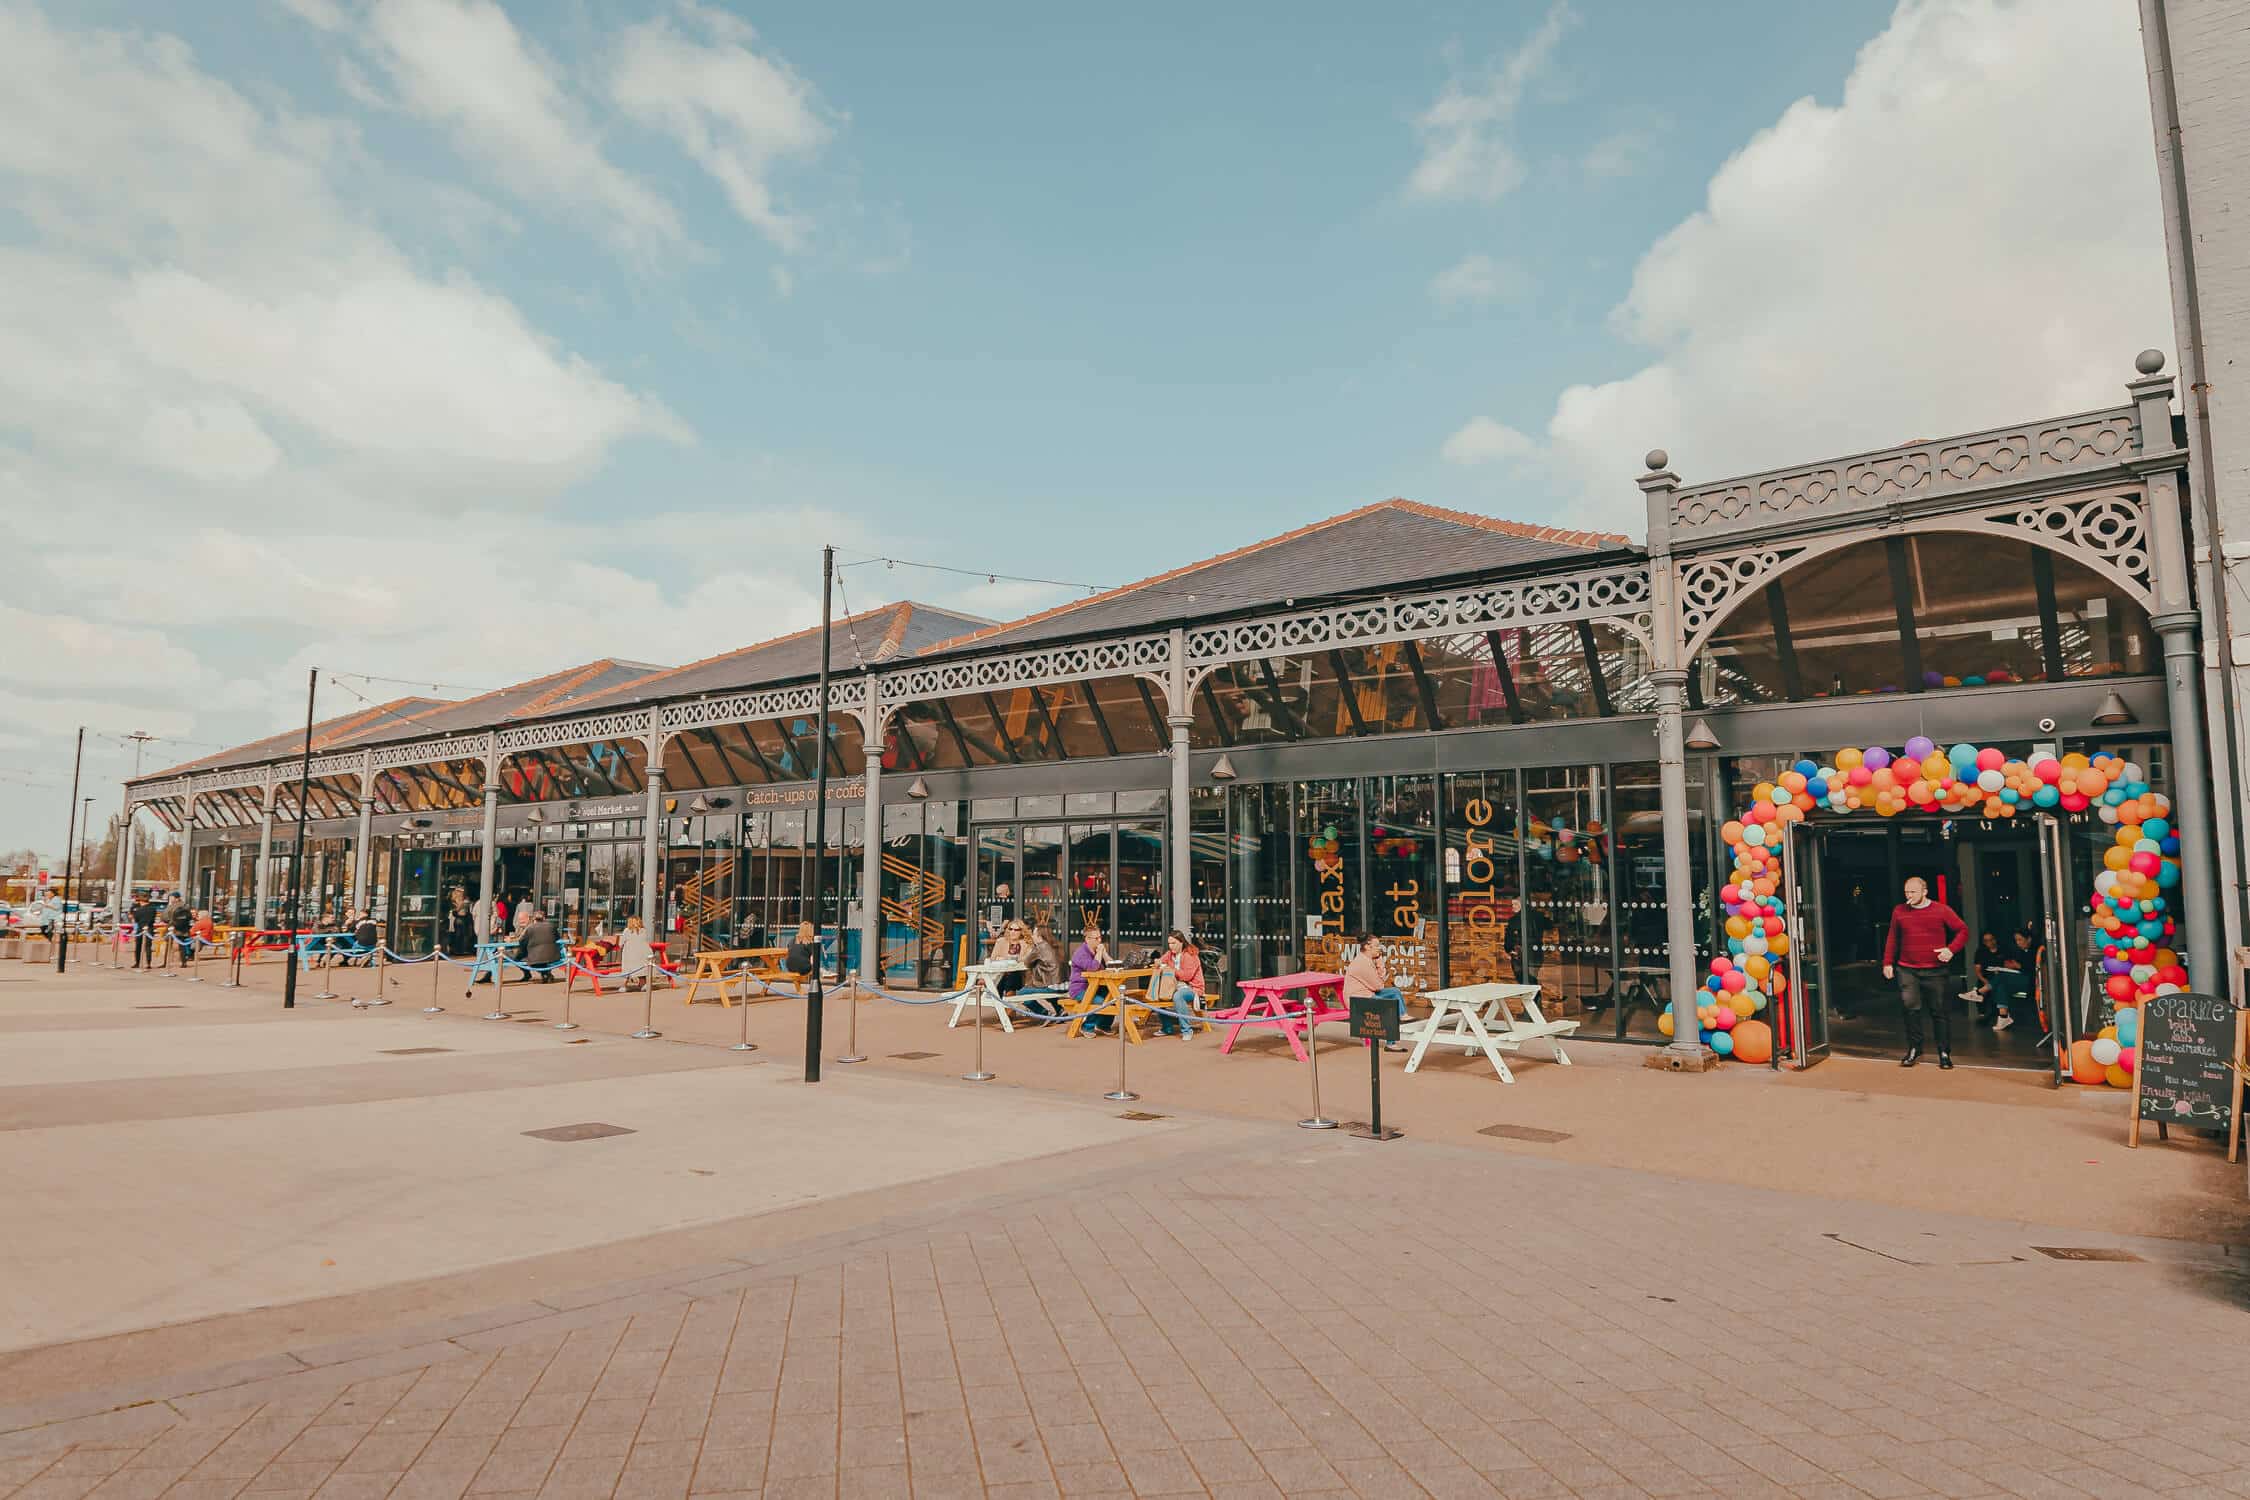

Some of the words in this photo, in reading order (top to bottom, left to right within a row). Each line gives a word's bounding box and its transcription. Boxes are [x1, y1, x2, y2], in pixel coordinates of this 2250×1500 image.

[746, 789, 804, 804] Catch-ups
[807, 788, 834, 800] ovr
[835, 783, 865, 799] coffe
[1314, 857, 1344, 974] elax
[1459, 798, 1504, 983] xplore
